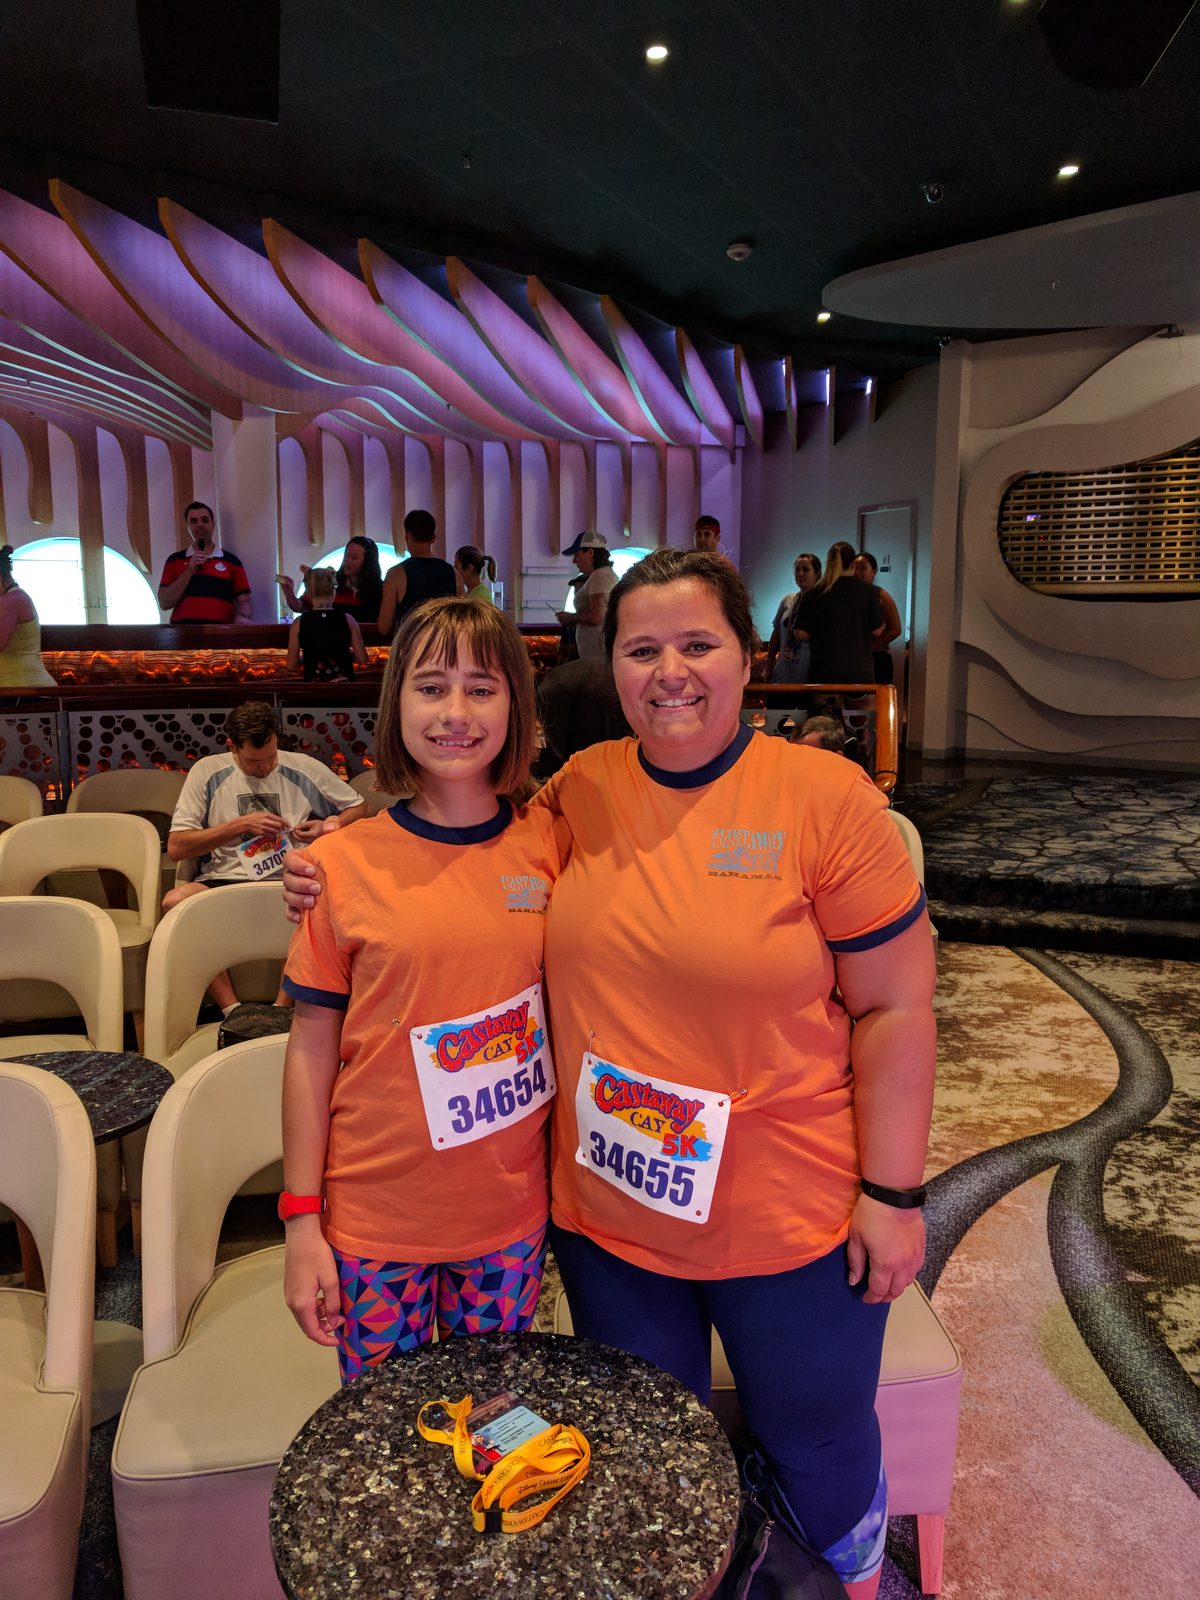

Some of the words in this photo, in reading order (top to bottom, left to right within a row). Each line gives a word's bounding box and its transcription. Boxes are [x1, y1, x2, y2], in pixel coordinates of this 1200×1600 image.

[437, 1001, 530, 1072] Castaway
[483, 1037, 514, 1061] CAY
[514, 1030, 540, 1066] 5K
[447, 1058, 547, 1134] 34654
[594, 1073, 705, 1134] Castaway
[629, 1111, 667, 1135] CAY
[661, 1133, 699, 1158] 5K
[589, 1130, 696, 1208] 34655
